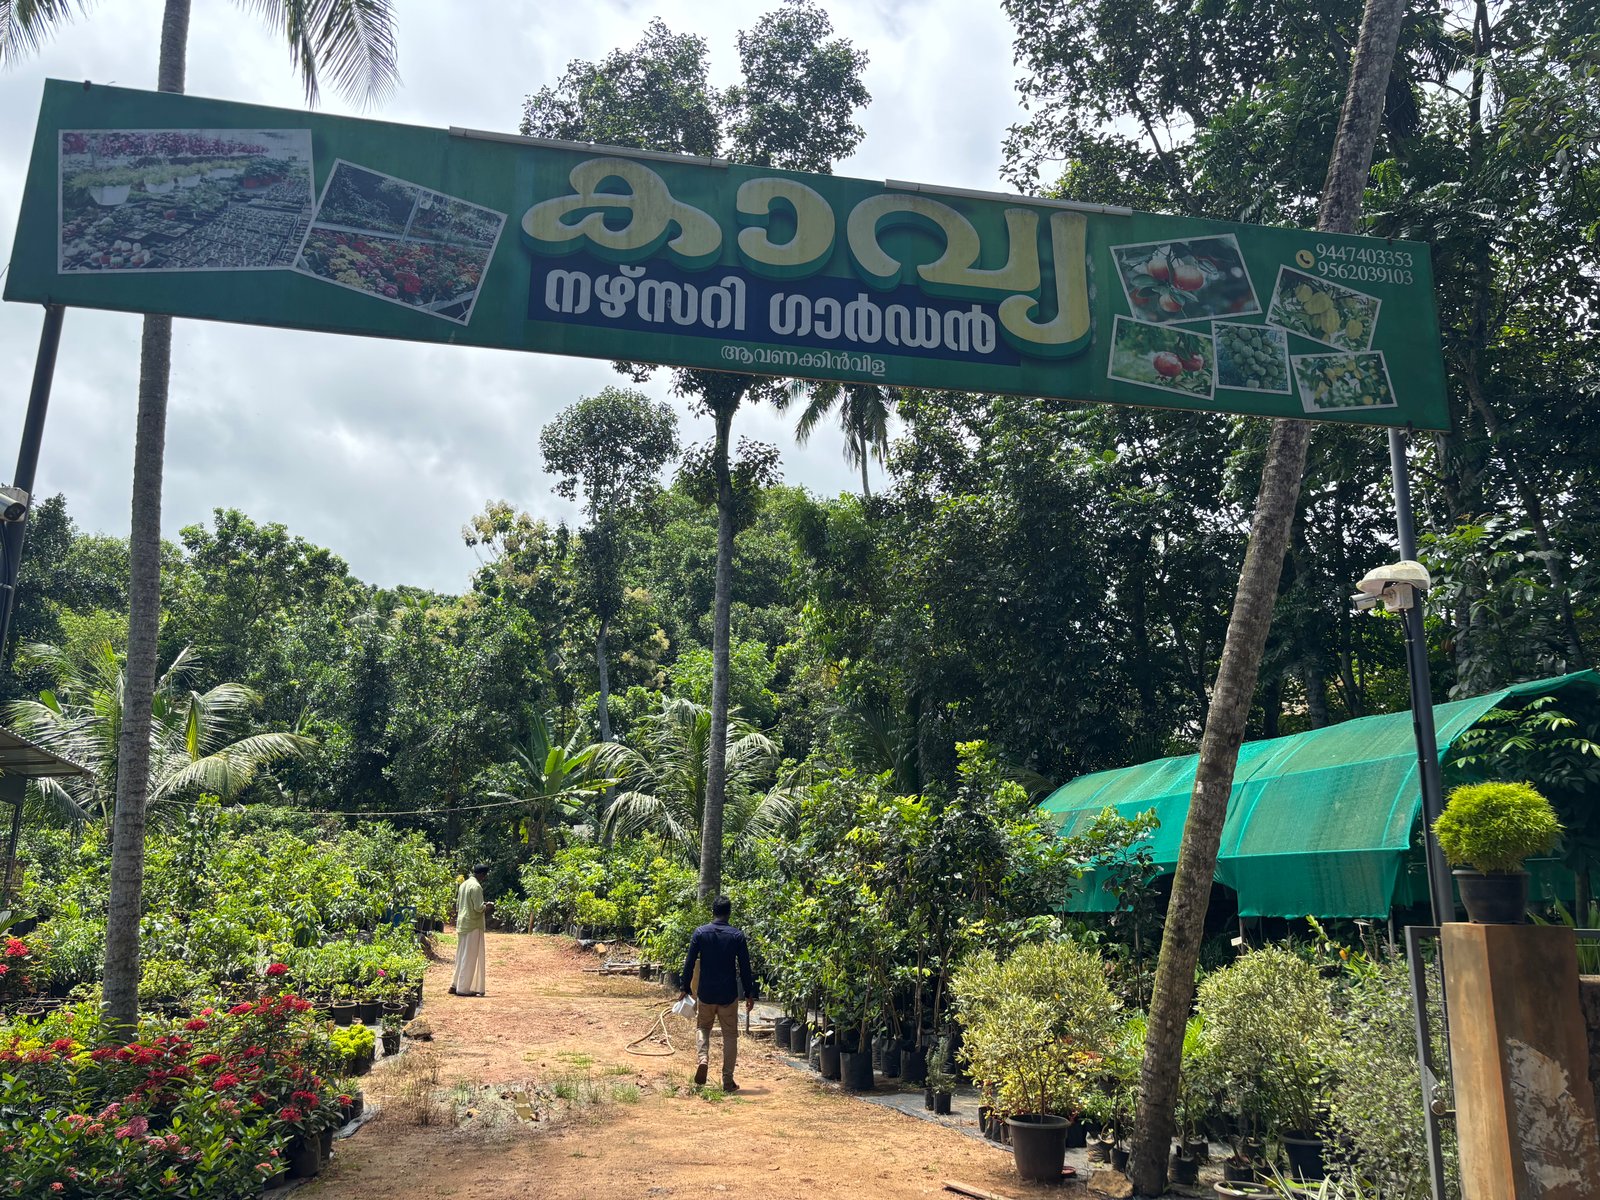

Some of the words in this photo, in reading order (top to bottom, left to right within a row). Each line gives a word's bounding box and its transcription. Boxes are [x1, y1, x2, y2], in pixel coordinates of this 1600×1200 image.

[520, 157, 1091, 350] കാവ്യ
[1316, 243, 1413, 267] 9447403353
[1318, 262, 1414, 285] 9562039103
[545, 265, 746, 331] നഴ്സറി
[769, 292, 996, 354] ഗാർഡൻ
[721, 344, 886, 376] ആവണക്കിൻവിള
